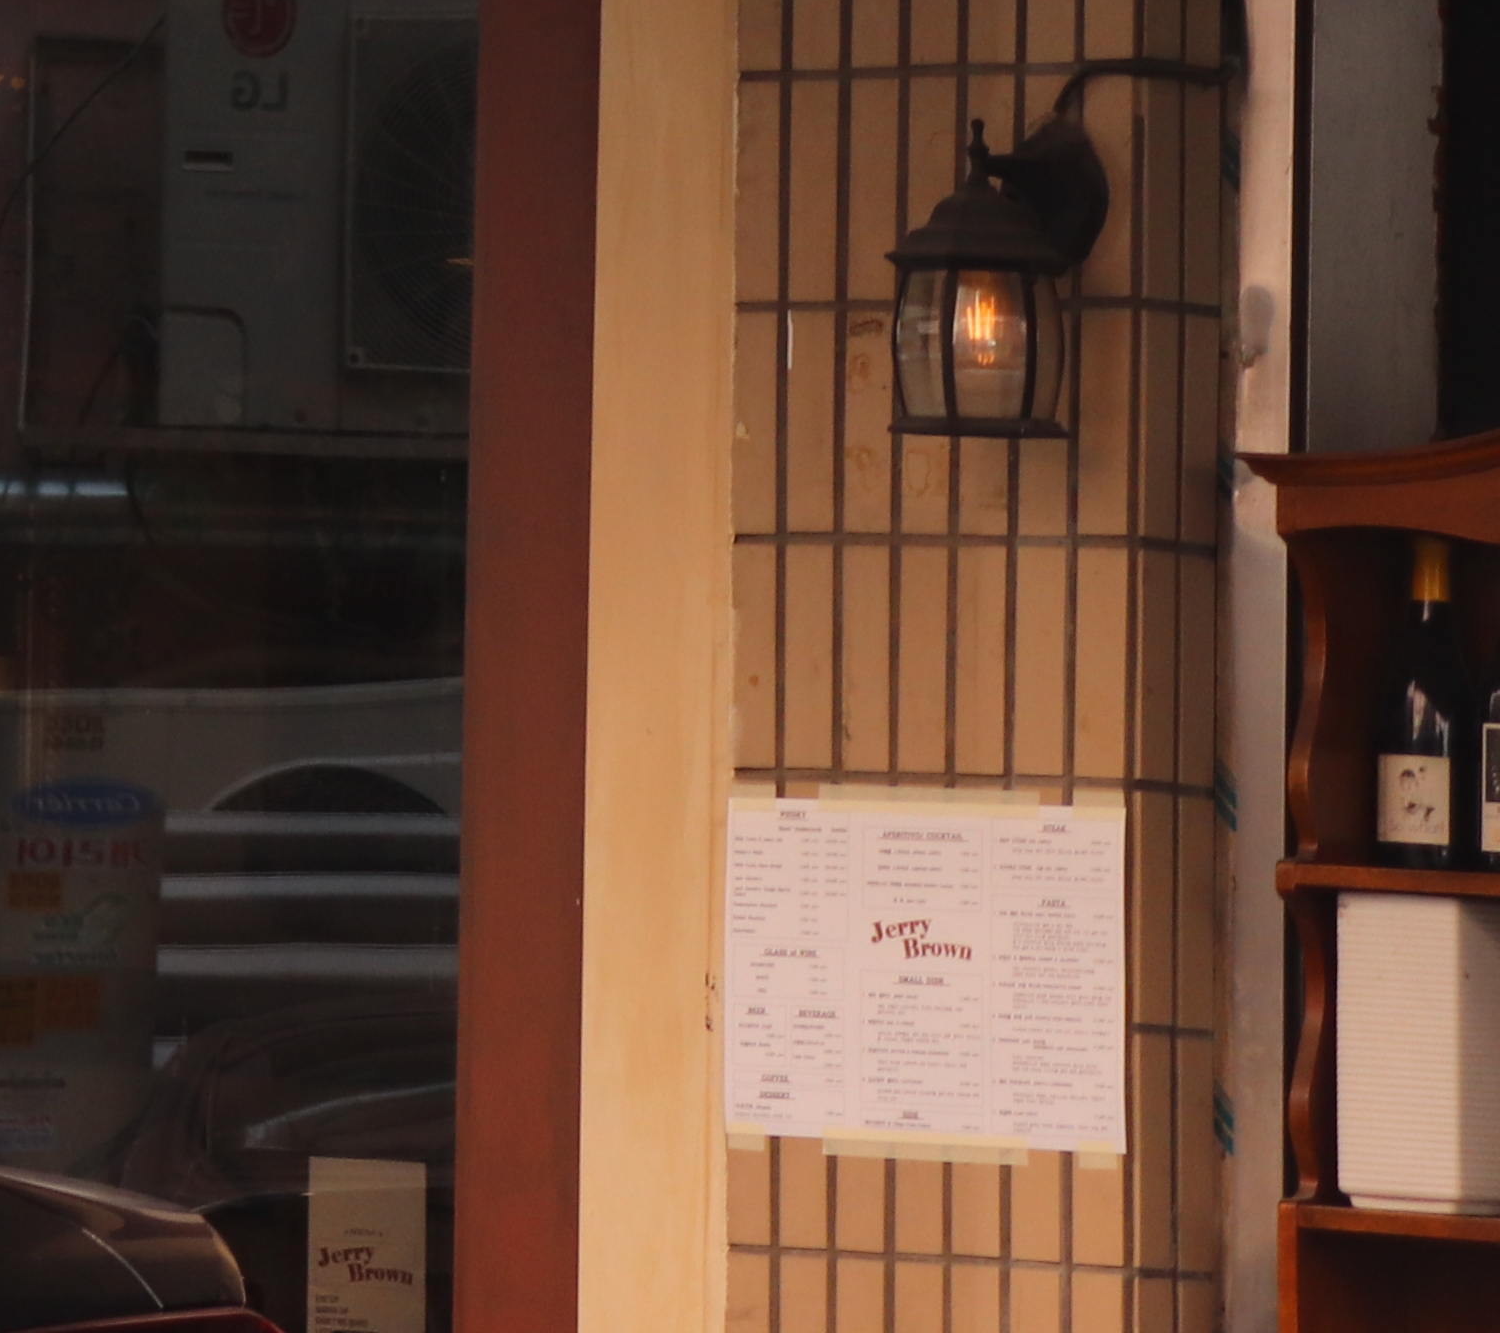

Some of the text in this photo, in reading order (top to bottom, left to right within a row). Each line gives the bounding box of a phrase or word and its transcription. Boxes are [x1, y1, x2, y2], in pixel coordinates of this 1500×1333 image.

[871, 918, 932, 944] Jerry
[902, 937, 973, 962] Brown
[317, 1246, 375, 1267] Jerry
[347, 1263, 414, 1285] Brown
